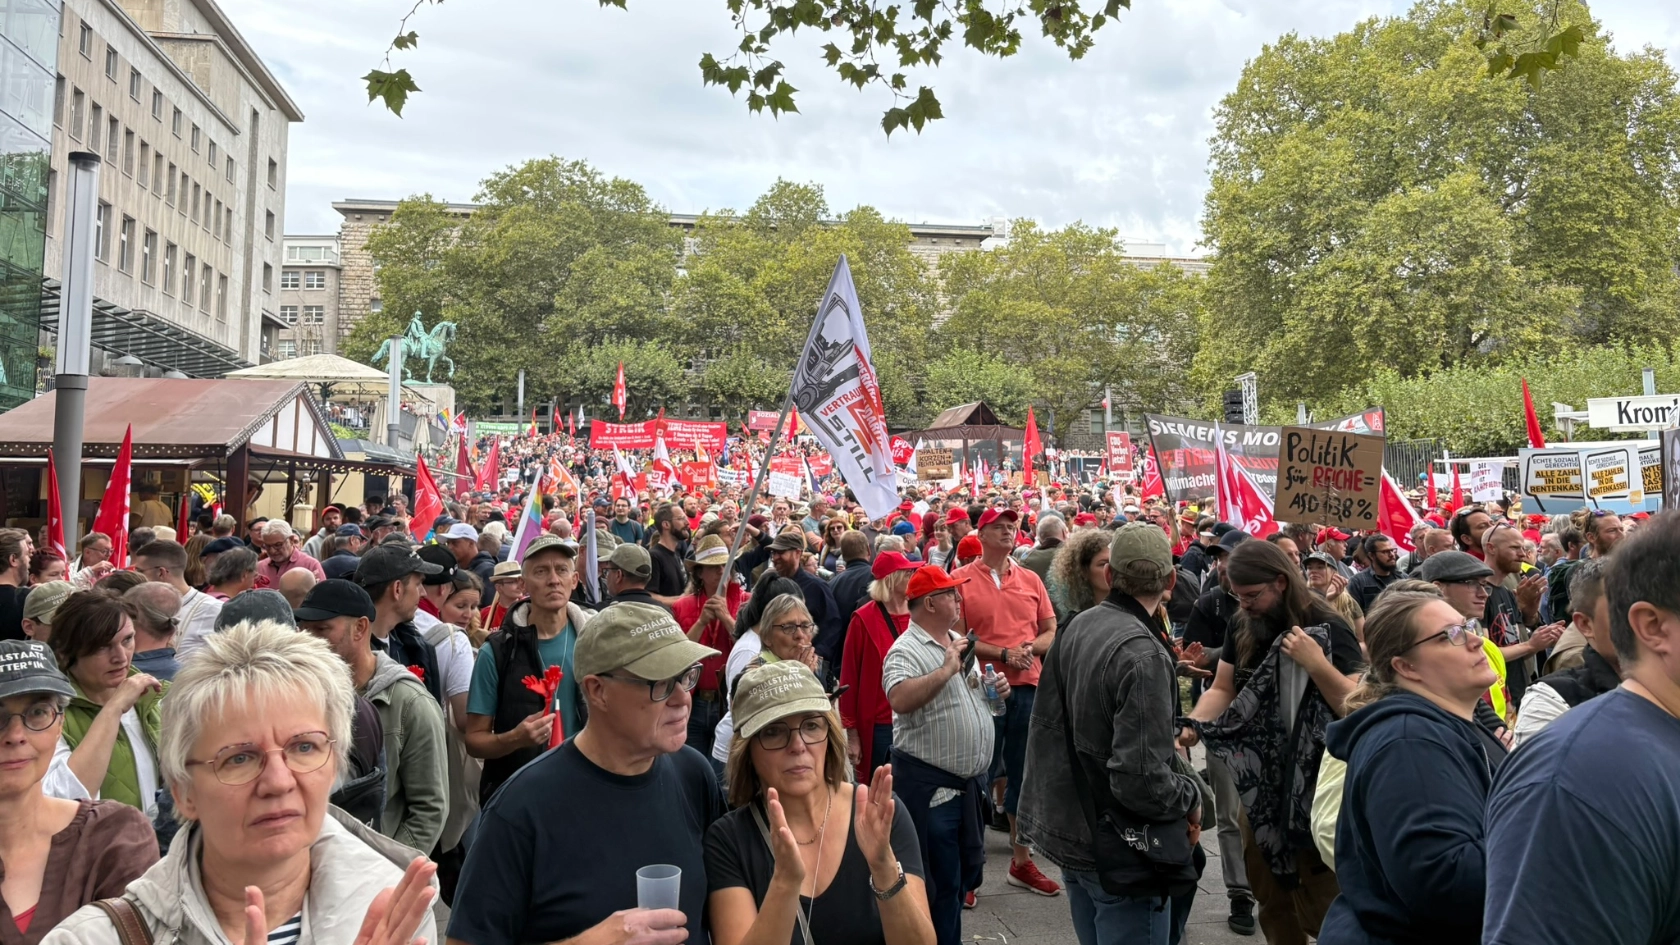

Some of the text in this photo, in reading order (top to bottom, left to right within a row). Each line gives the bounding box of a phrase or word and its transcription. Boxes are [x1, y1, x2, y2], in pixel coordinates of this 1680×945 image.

[1617, 398, 1678, 424] Krom
[605, 423, 645, 434] STREIK
[1149, 419, 1281, 446] SIEMENS MO
[828, 414, 875, 484] STILL
[1110, 446, 1129, 455] Verbot
[1287, 432, 1358, 468] Politik
[1284, 465, 1308, 491] für
[1535, 468, 1581, 478] ALLE ZAHL
[1591, 467, 1624, 480] ALLE ZAHLEN
[1605, 477, 1614, 485] DIE
[1165, 473, 1215, 491] Mitmache
[1530, 484, 1583, 493] RENTENKASS
[630, 616, 674, 637] SOZIALST
[648, 625, 682, 640] RETTER
